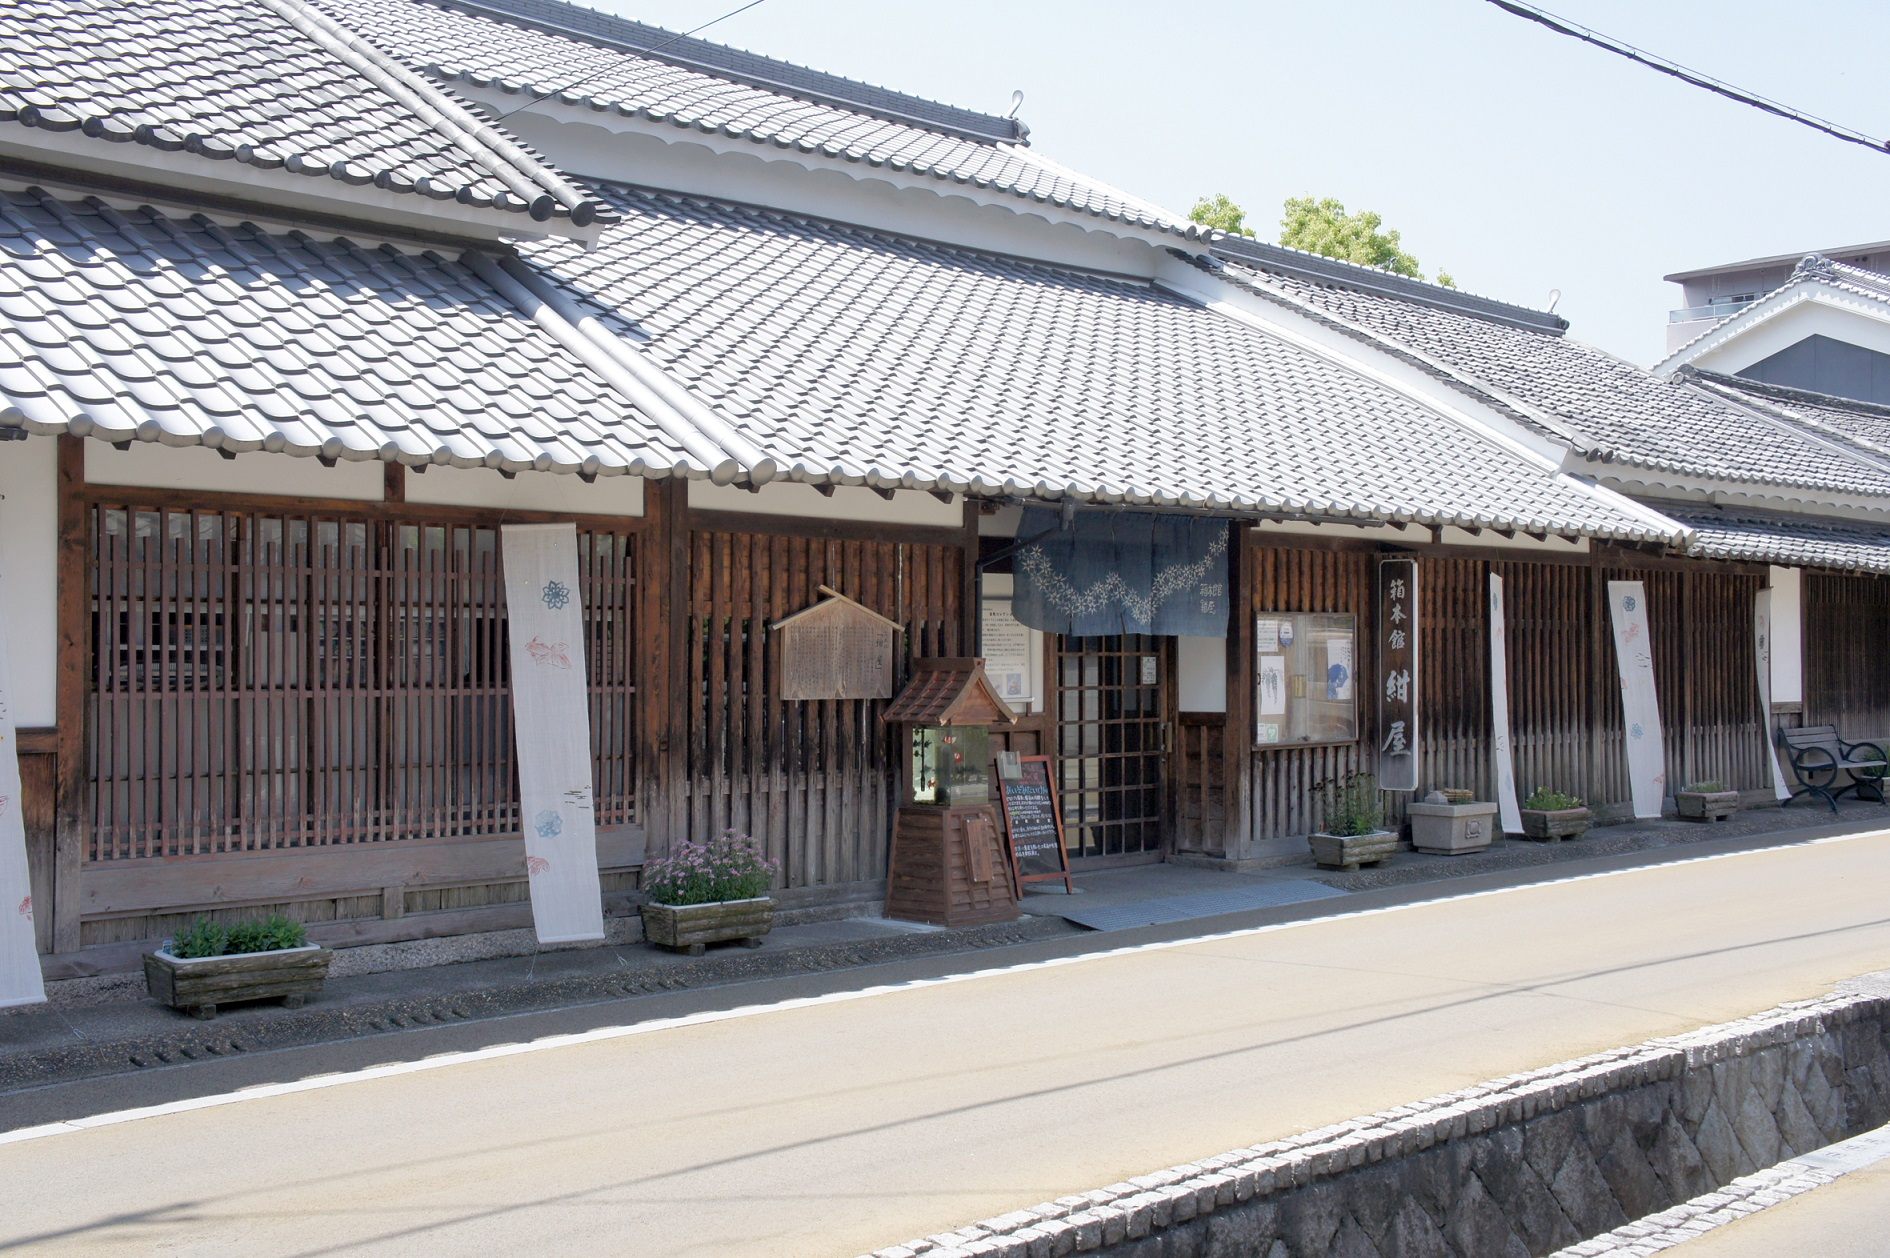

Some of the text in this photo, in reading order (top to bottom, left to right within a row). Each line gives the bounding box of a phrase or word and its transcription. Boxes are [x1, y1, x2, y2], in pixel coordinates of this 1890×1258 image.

[1382, 579, 1411, 756] 箱本館 紺屋
